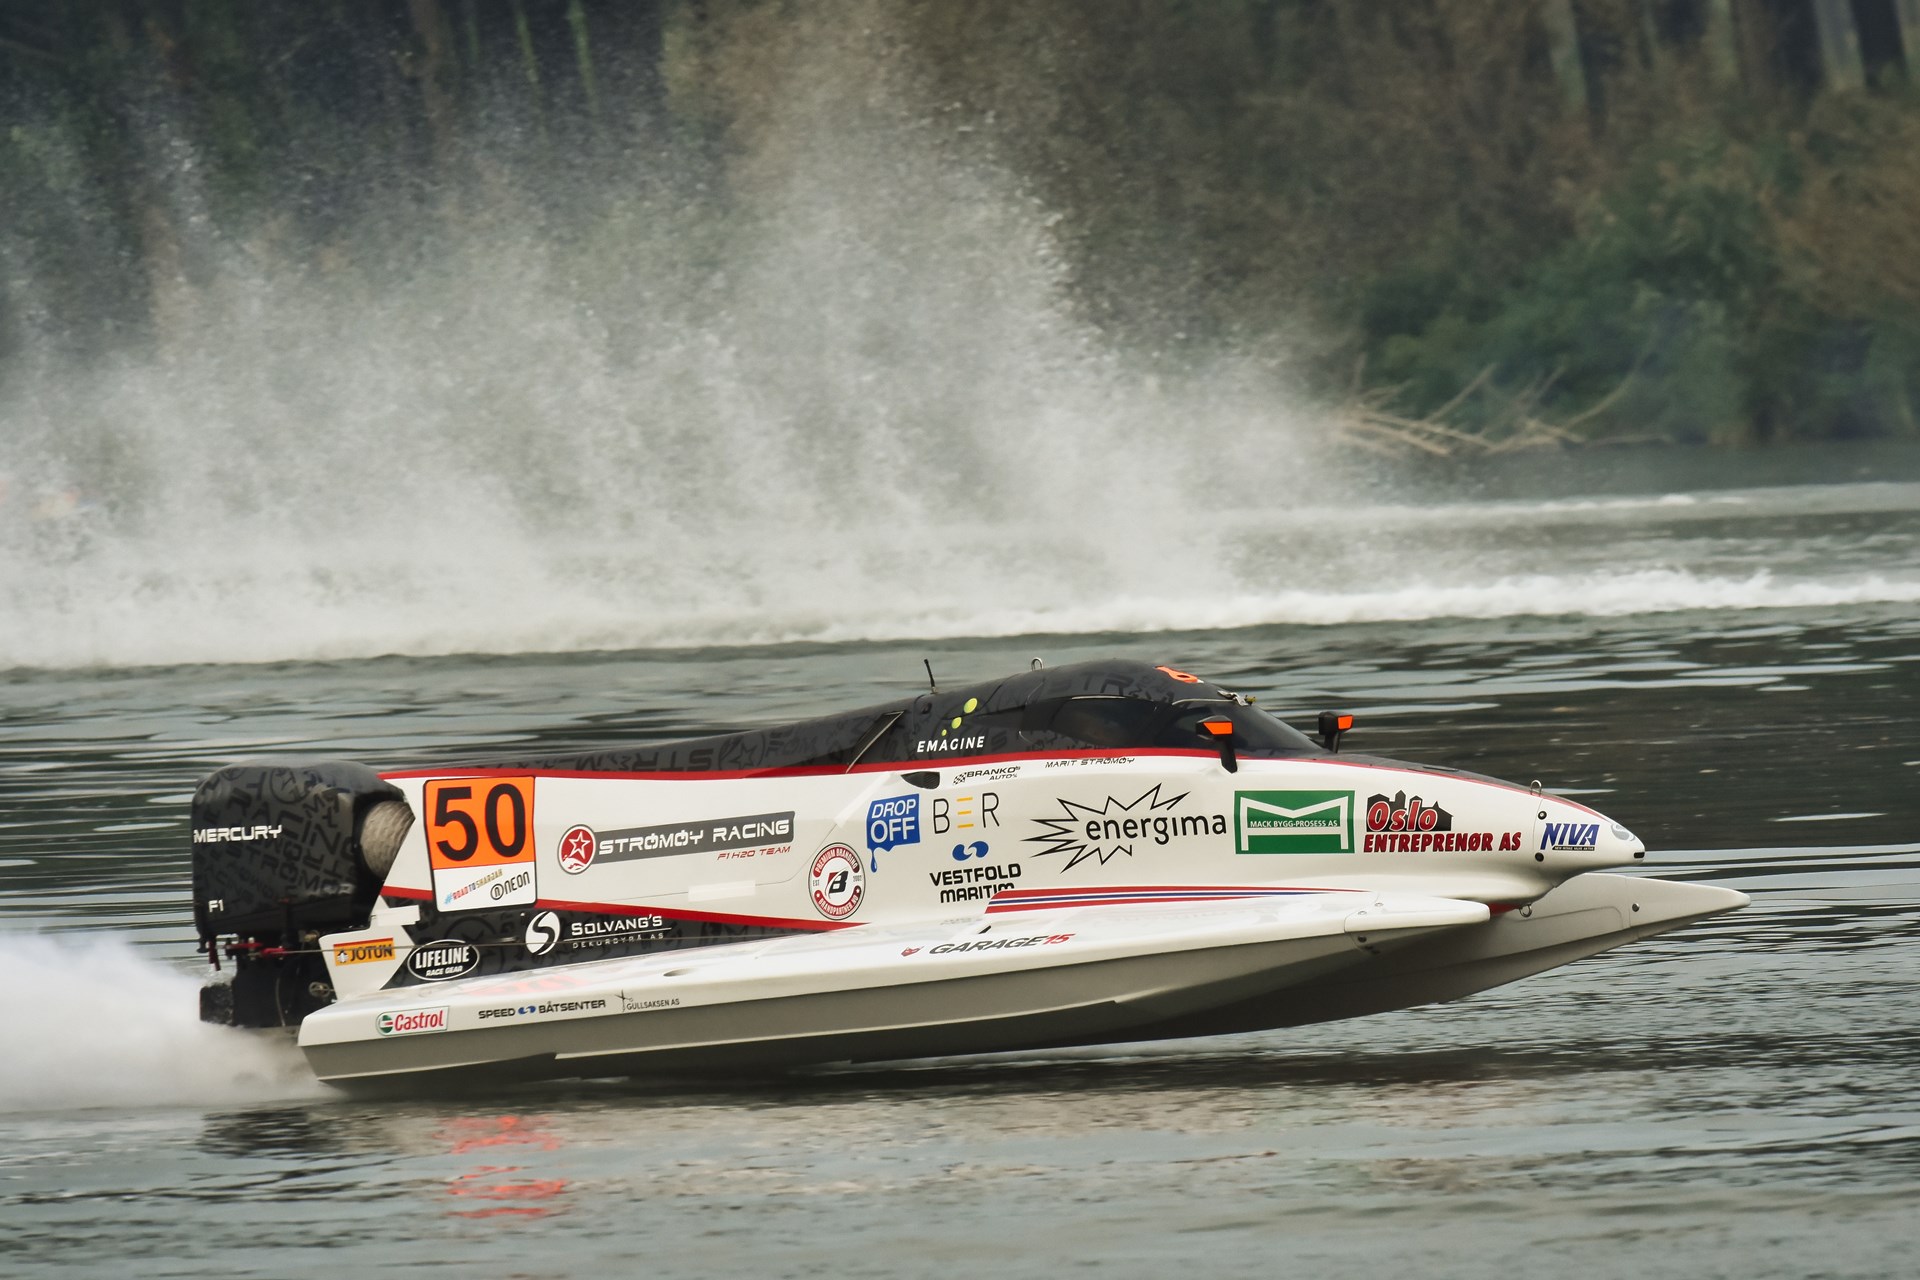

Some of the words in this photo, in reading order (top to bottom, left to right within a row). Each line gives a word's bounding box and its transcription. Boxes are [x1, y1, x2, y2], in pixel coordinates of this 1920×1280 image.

[916, 735, 986, 753] EMAGINE
[1044, 759, 1077, 769] MARIT
[871, 798, 917, 819] DROP
[1366, 799, 1439, 832] Oslo
[434, 782, 527, 862] 50
[712, 818, 790, 842] RACING
[870, 816, 916, 844] OFF
[1085, 814, 1227, 846] energima
[1250, 820, 1272, 828] MACK
[1273, 819, 1326, 828] BYGG-PROSESS
[193, 824, 283, 843] MERCURY
[1363, 832, 1494, 853] ENTREPRENØR
[1498, 831, 1522, 852] AS
[1540, 822, 1601, 851] NIVA
[760, 845, 791, 856] TEAM
[929, 863, 1022, 887] VESTFOLD
[208, 899, 224, 912] F1
[571, 914, 663, 936] SOLVANG'S
[650, 932, 664, 940] AS
[350, 944, 393, 962] JOTUN
[415, 946, 470, 969] LIFELINE
[425, 969, 444, 977] RACE
[444, 965, 464, 974] GEAR
[478, 1007, 516, 1019] SPEED
[538, 999, 607, 1014] BÅTSENTER
[626, 1000, 669, 1011] GULLSAKSEN
[670, 998, 680, 1006] AS
[394, 1010, 444, 1032] Castrol
